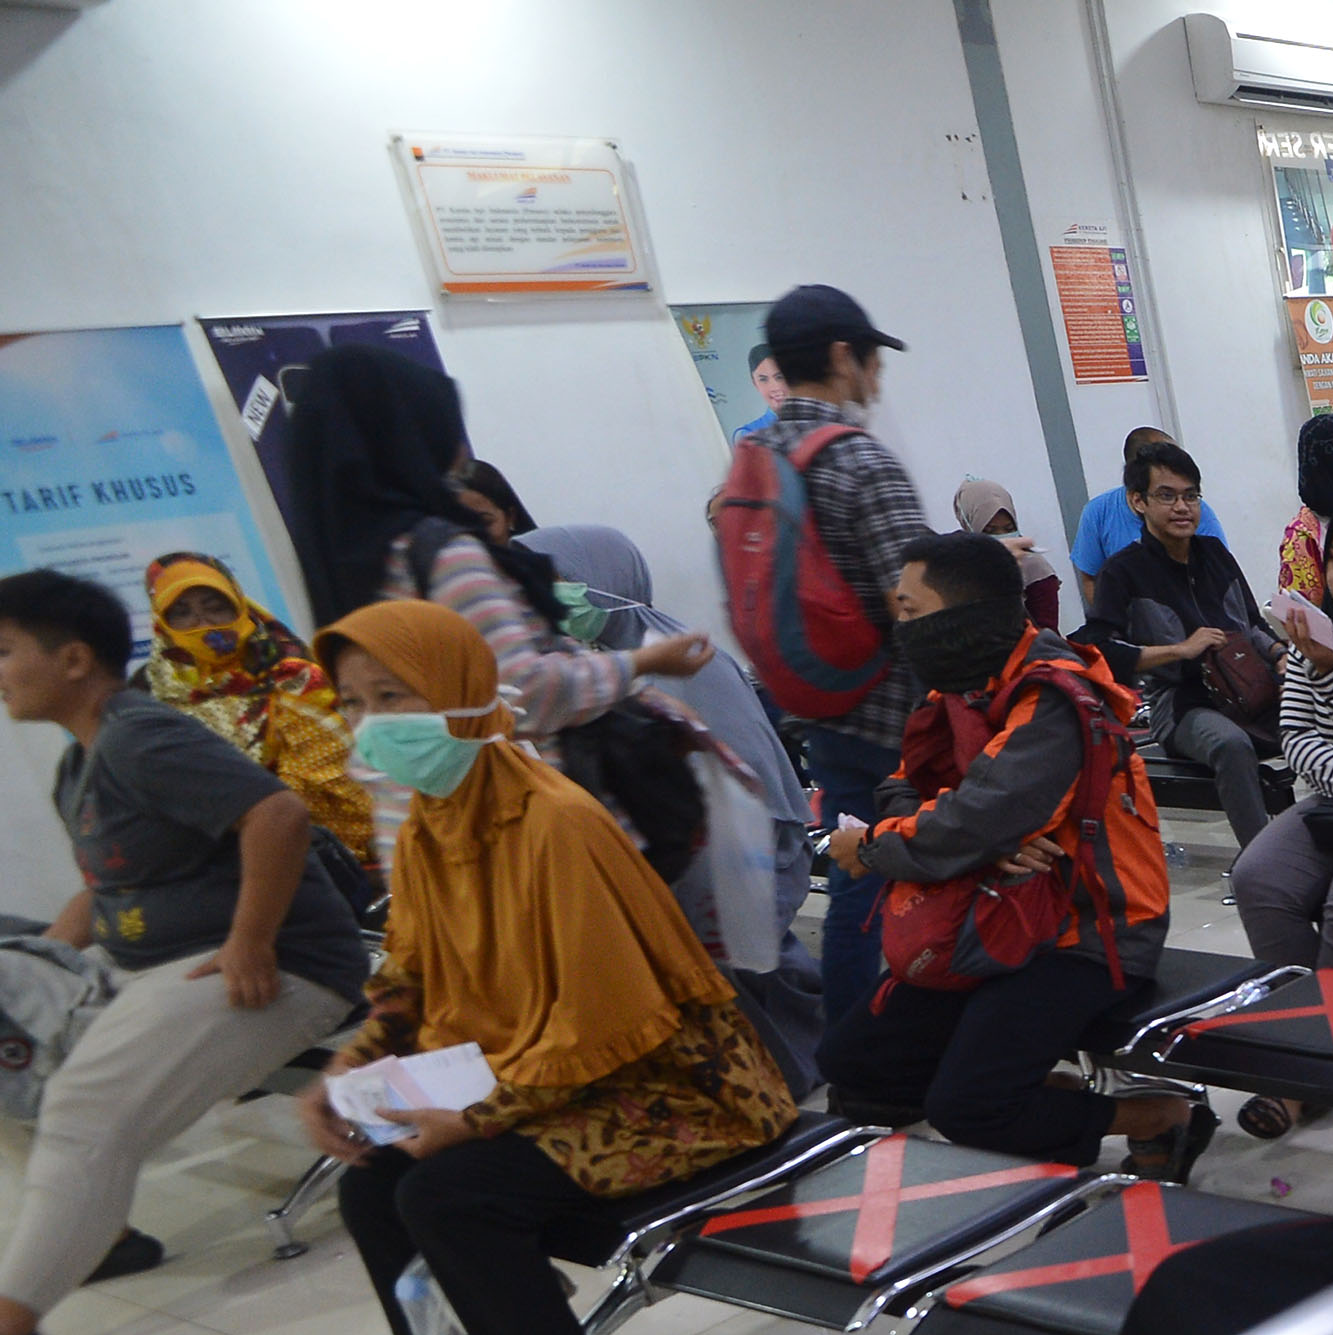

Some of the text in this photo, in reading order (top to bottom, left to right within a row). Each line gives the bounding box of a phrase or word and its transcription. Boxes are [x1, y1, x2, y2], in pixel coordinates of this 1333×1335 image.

[247, 387, 274, 427] NEW
[1, 473, 197, 513] TARIF KHUSUS
